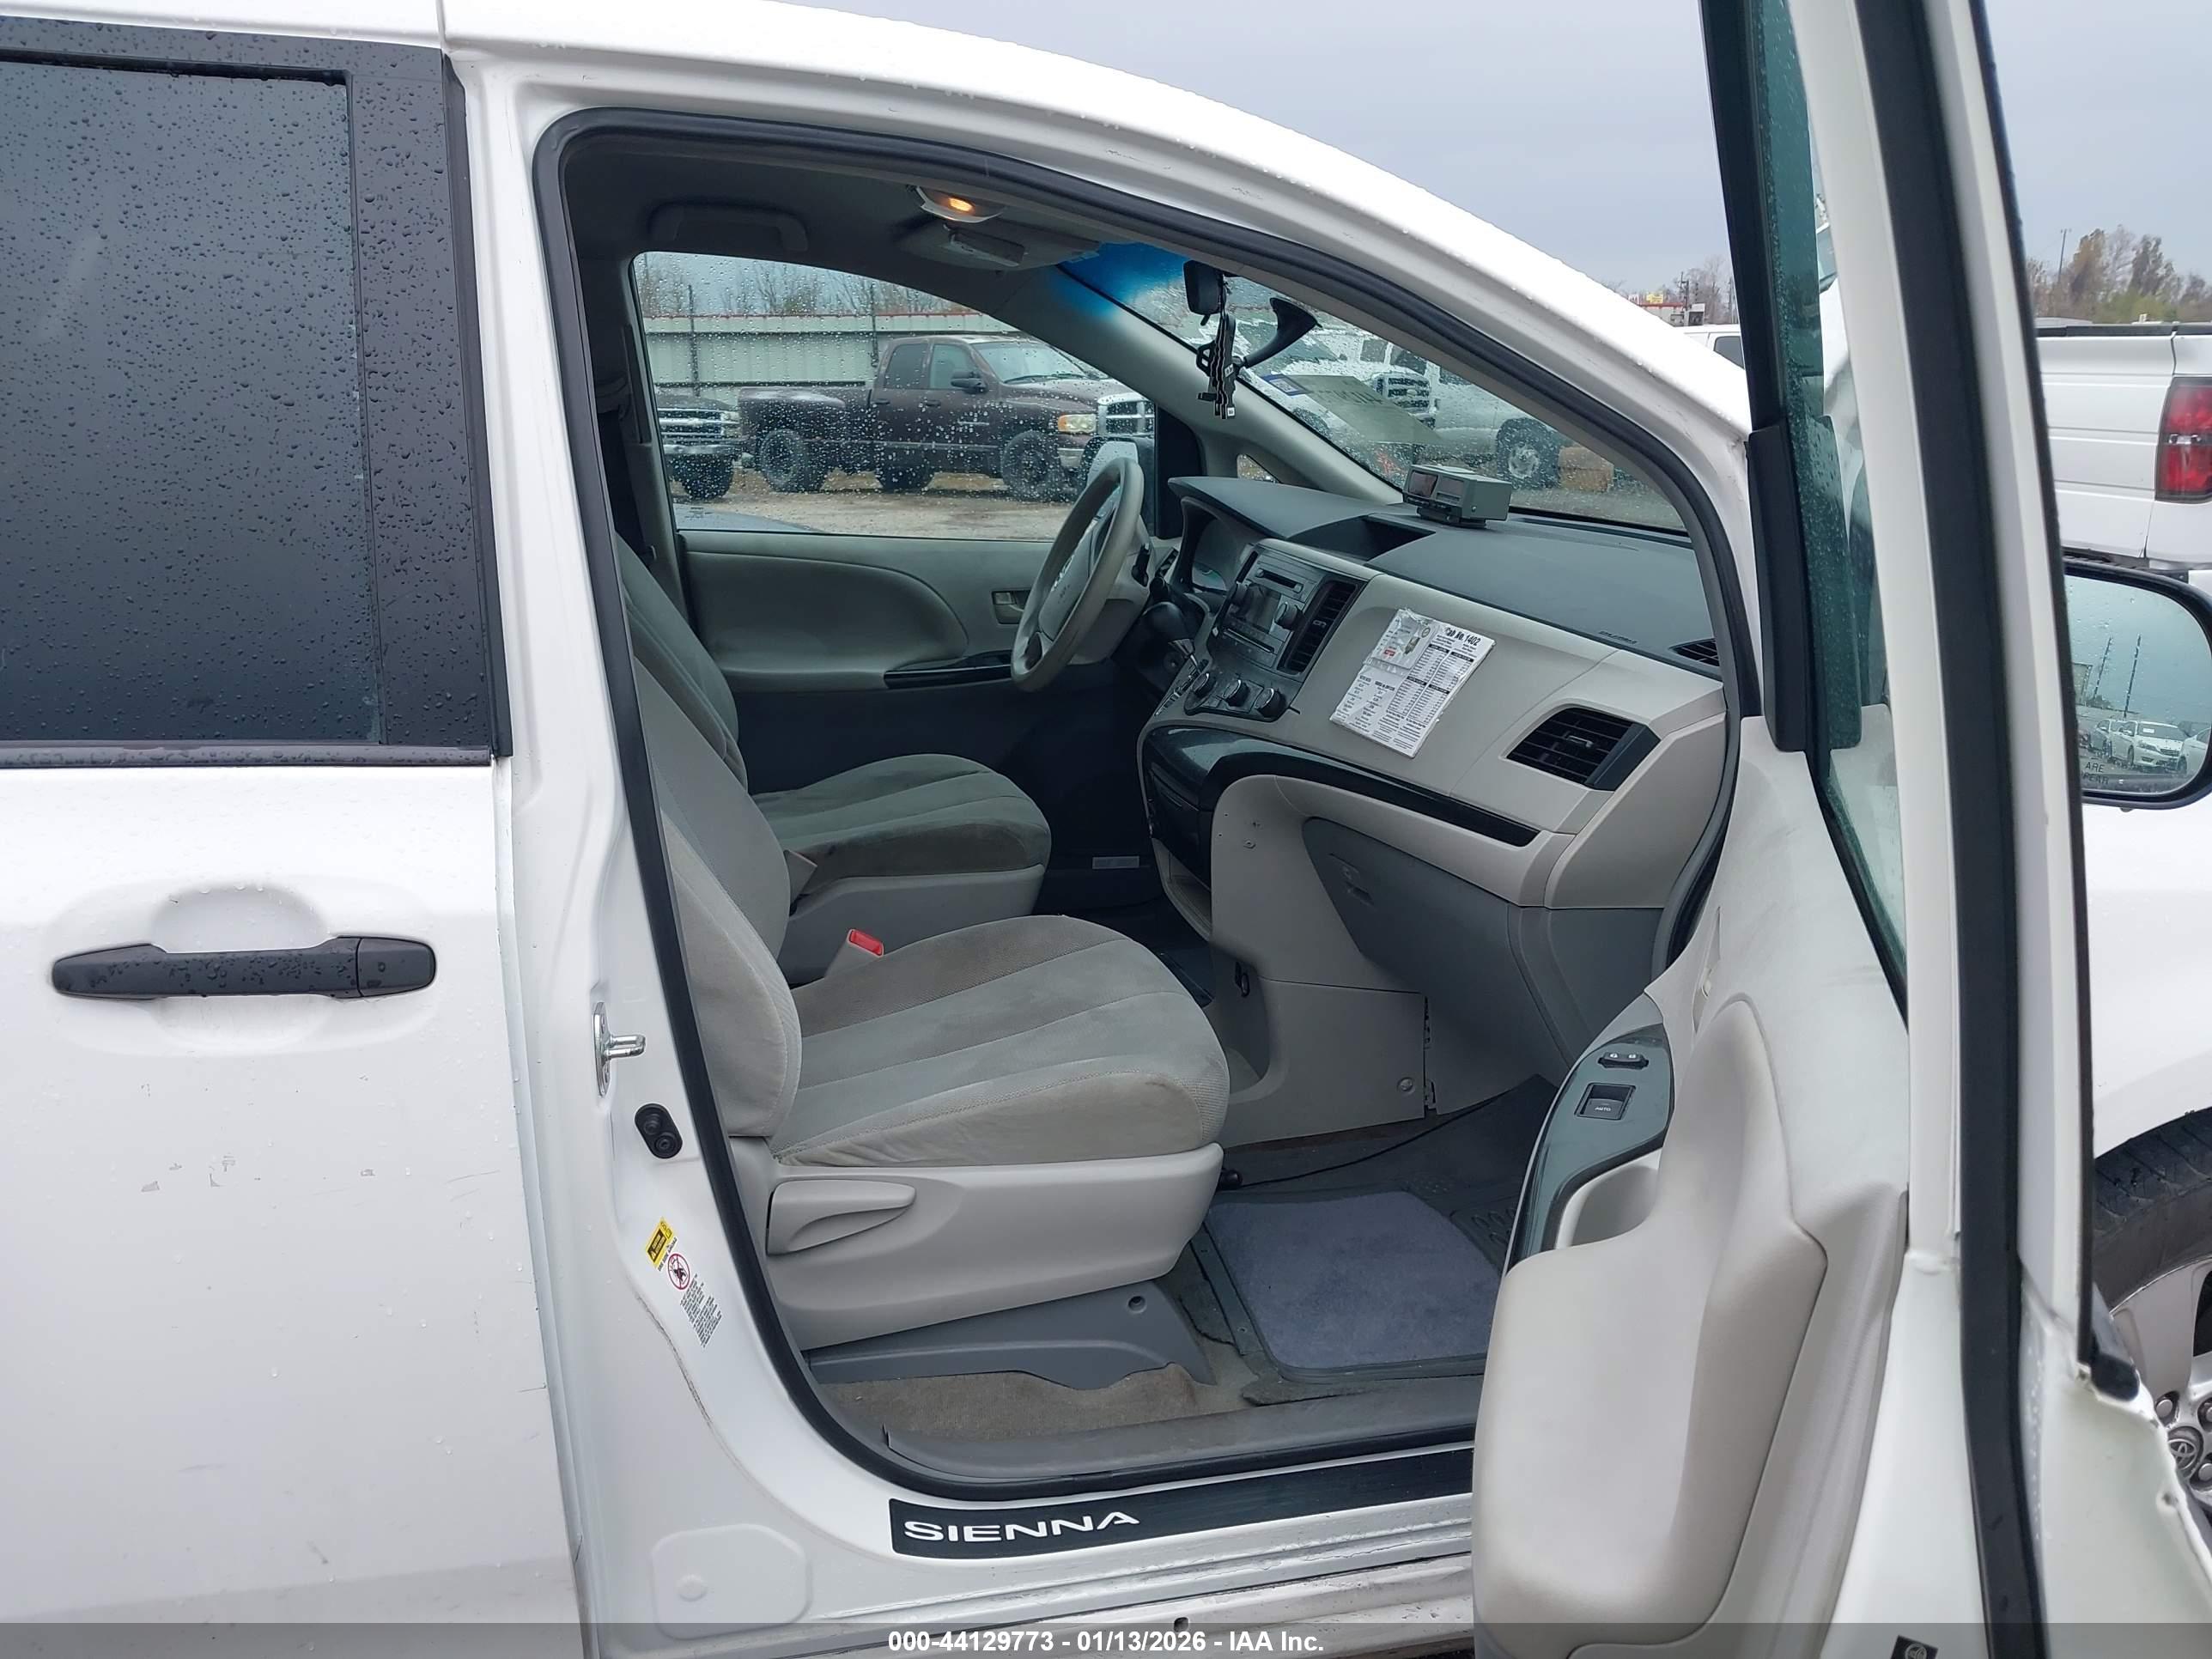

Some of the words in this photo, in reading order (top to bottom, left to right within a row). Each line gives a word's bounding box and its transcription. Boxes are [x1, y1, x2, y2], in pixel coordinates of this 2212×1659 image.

[1465, 634, 1481, 647] 1402
[2086, 762, 2105, 773] ARE
[904, 1511, 1140, 1542] SIENNA
